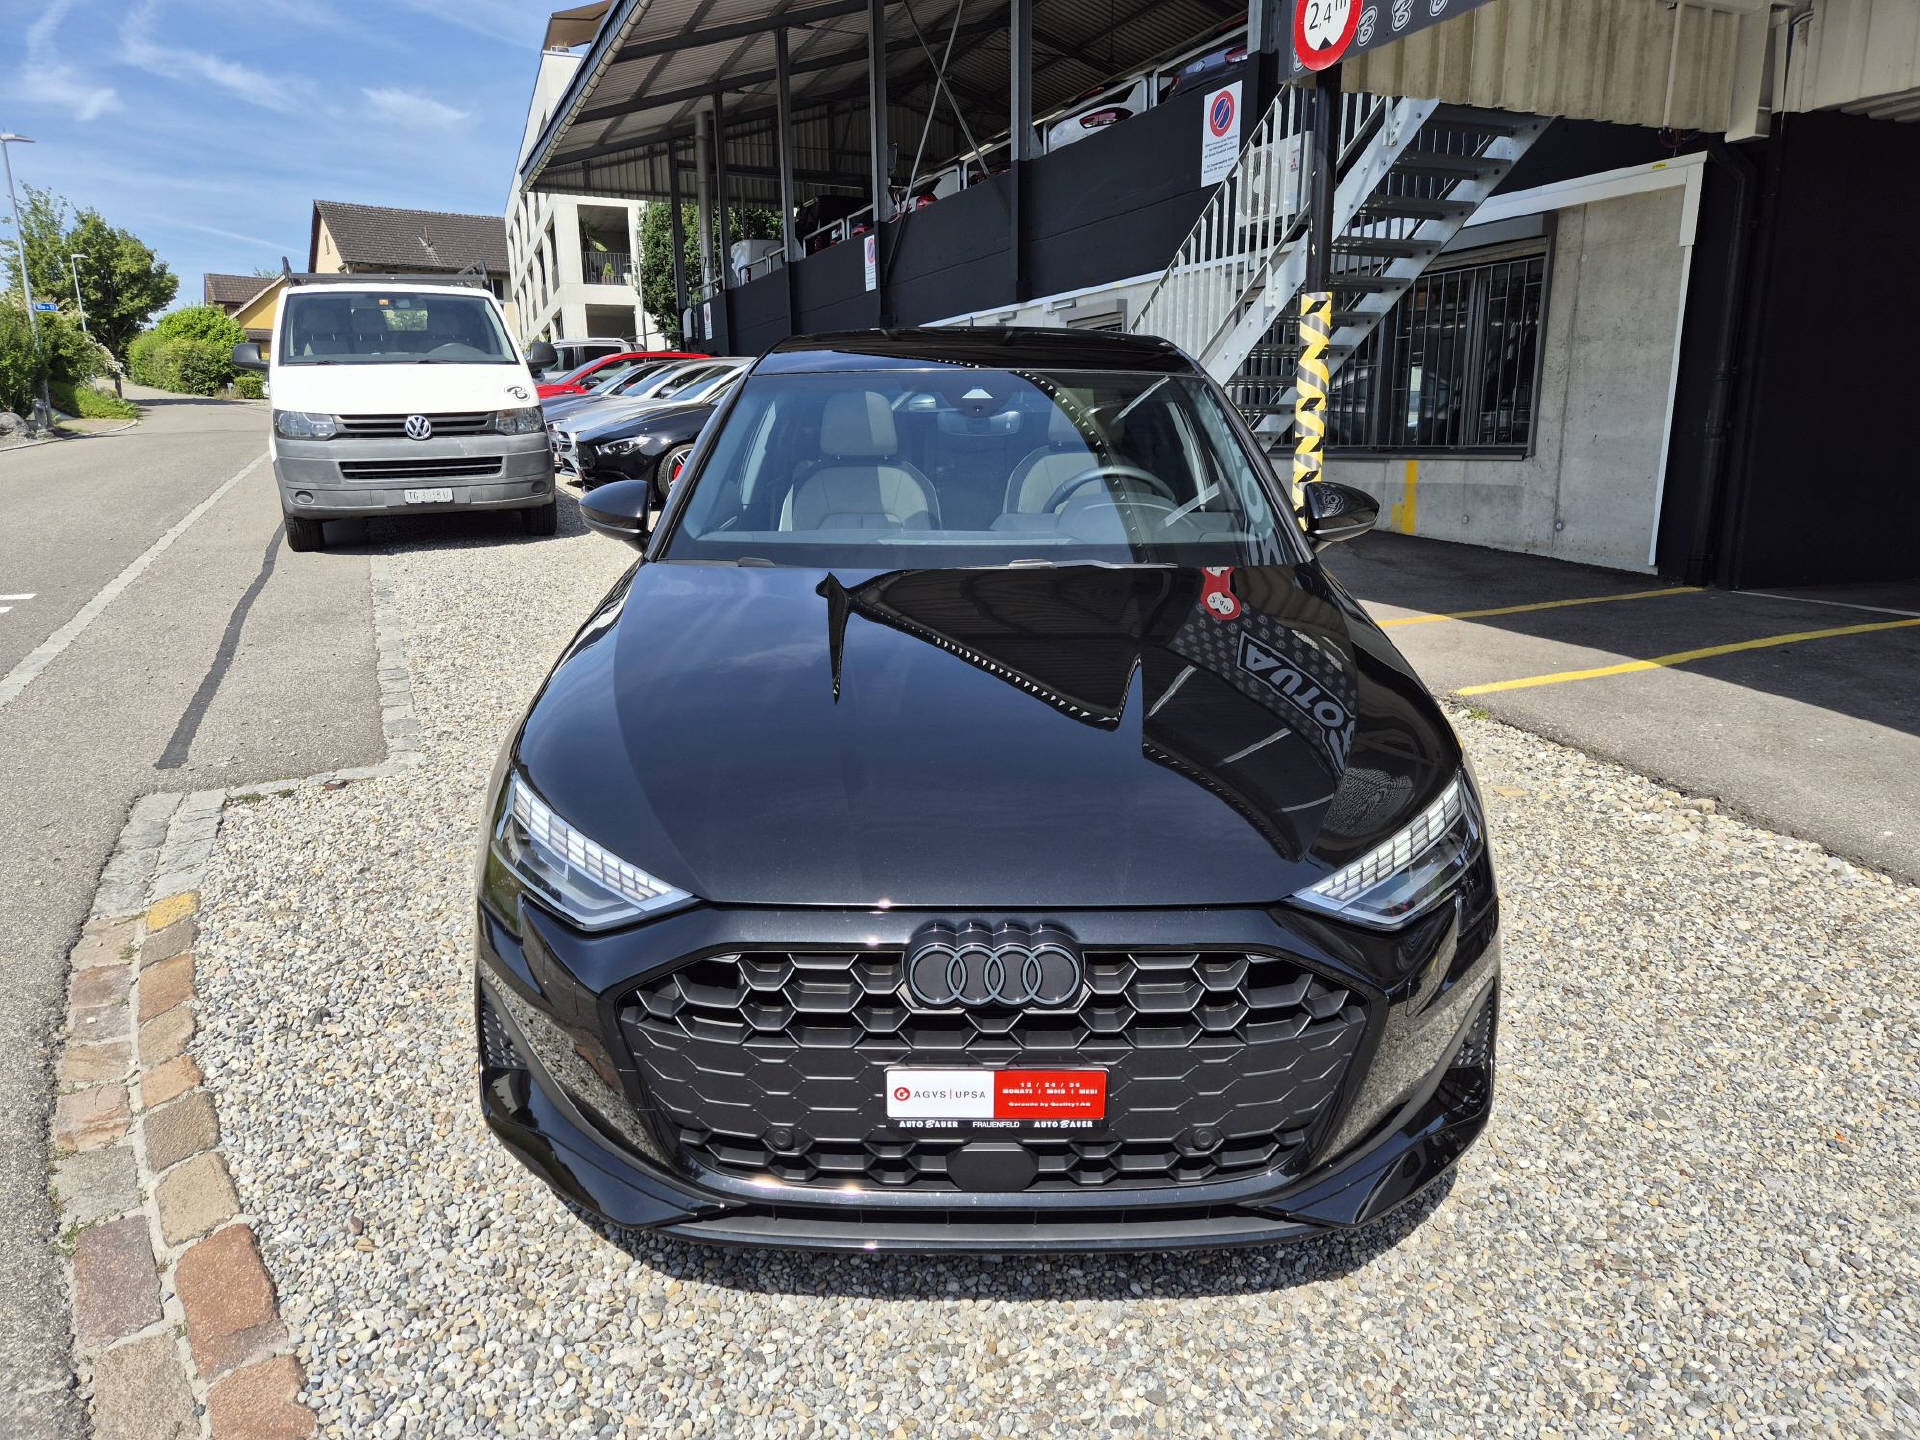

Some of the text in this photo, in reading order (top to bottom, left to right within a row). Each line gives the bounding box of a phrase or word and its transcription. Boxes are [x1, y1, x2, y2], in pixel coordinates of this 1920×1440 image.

[1308, 3, 1332, 31] 2,4
[913, 1090, 946, 1098] AGVS
[955, 1090, 986, 1098] UPSA
